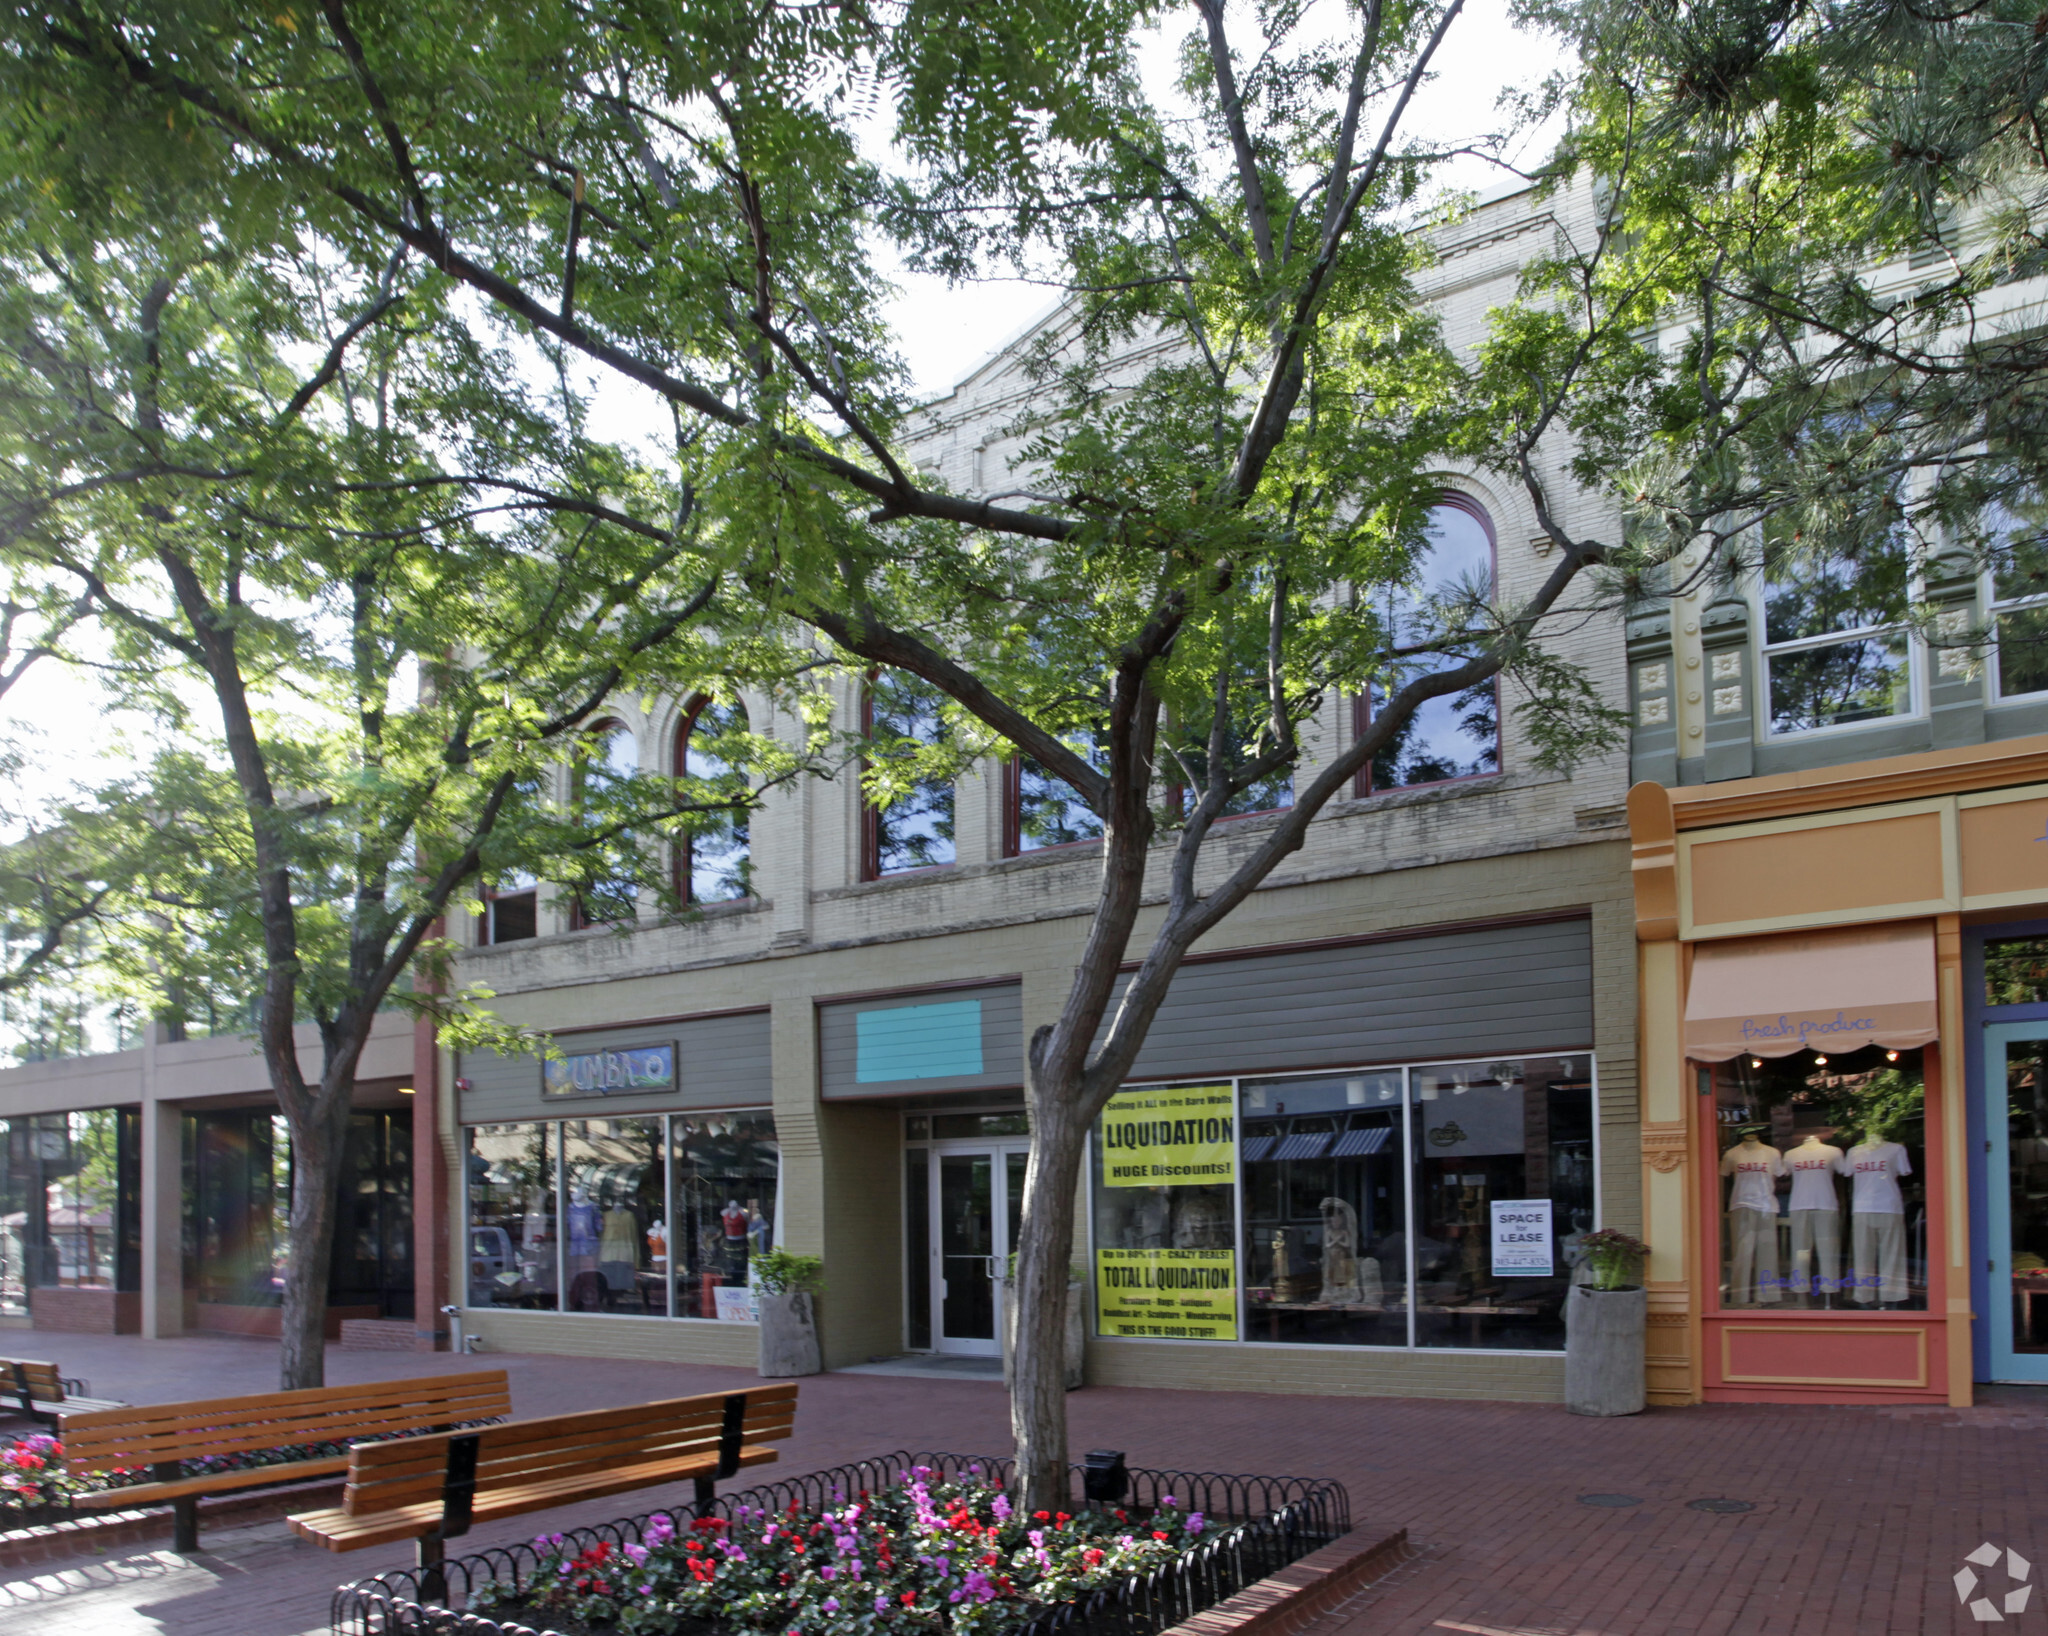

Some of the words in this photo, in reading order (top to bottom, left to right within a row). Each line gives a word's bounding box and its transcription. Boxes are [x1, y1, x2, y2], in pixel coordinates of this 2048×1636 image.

[1740, 1016, 1795, 1040] fresh
[1797, 1012, 1877, 1042] produce
[1107, 1101, 1135, 1111] Selling
[1145, 1099, 1157, 1108] ALL
[1159, 1099, 1167, 1107] to
[1169, 1098, 1183, 1106] the
[1185, 1096, 1205, 1106] Bare
[1207, 1095, 1232, 1105] Walls
[1107, 1117, 1233, 1150] LIQUIDATION
[1113, 1165, 1148, 1177] HUGE
[1152, 1162, 1231, 1176] Discounts!
[1737, 1162, 1769, 1173] SALE
[1793, 1160, 1826, 1172] SALE
[1854, 1160, 1887, 1173] SALE
[1499, 1213, 1544, 1224] SPACE
[1500, 1233, 1544, 1243] LEASE
[1103, 1251, 1114, 1259] Up
[1168, 1251, 1195, 1259] CRAZY
[1199, 1251, 1229, 1259] DEALS!
[1104, 1266, 1142, 1288] TOTAL
[1145, 1267, 1230, 1291] LIQUIDATION
[1757, 1269, 1808, 1294] fresh
[1810, 1268, 1888, 1297] produce
[1157, 1298, 1175, 1307] Rugs
[1147, 1310, 1180, 1319] Sculpture
[1186, 1312, 1233, 1322] Woodcarving
[1118, 1324, 1136, 1335] THIS
[1138, 1325, 1146, 1335] IS
[1148, 1326, 1162, 1336] THE
[1165, 1326, 1187, 1337] GOOD
[1189, 1327, 1216, 1337] STUFF!
